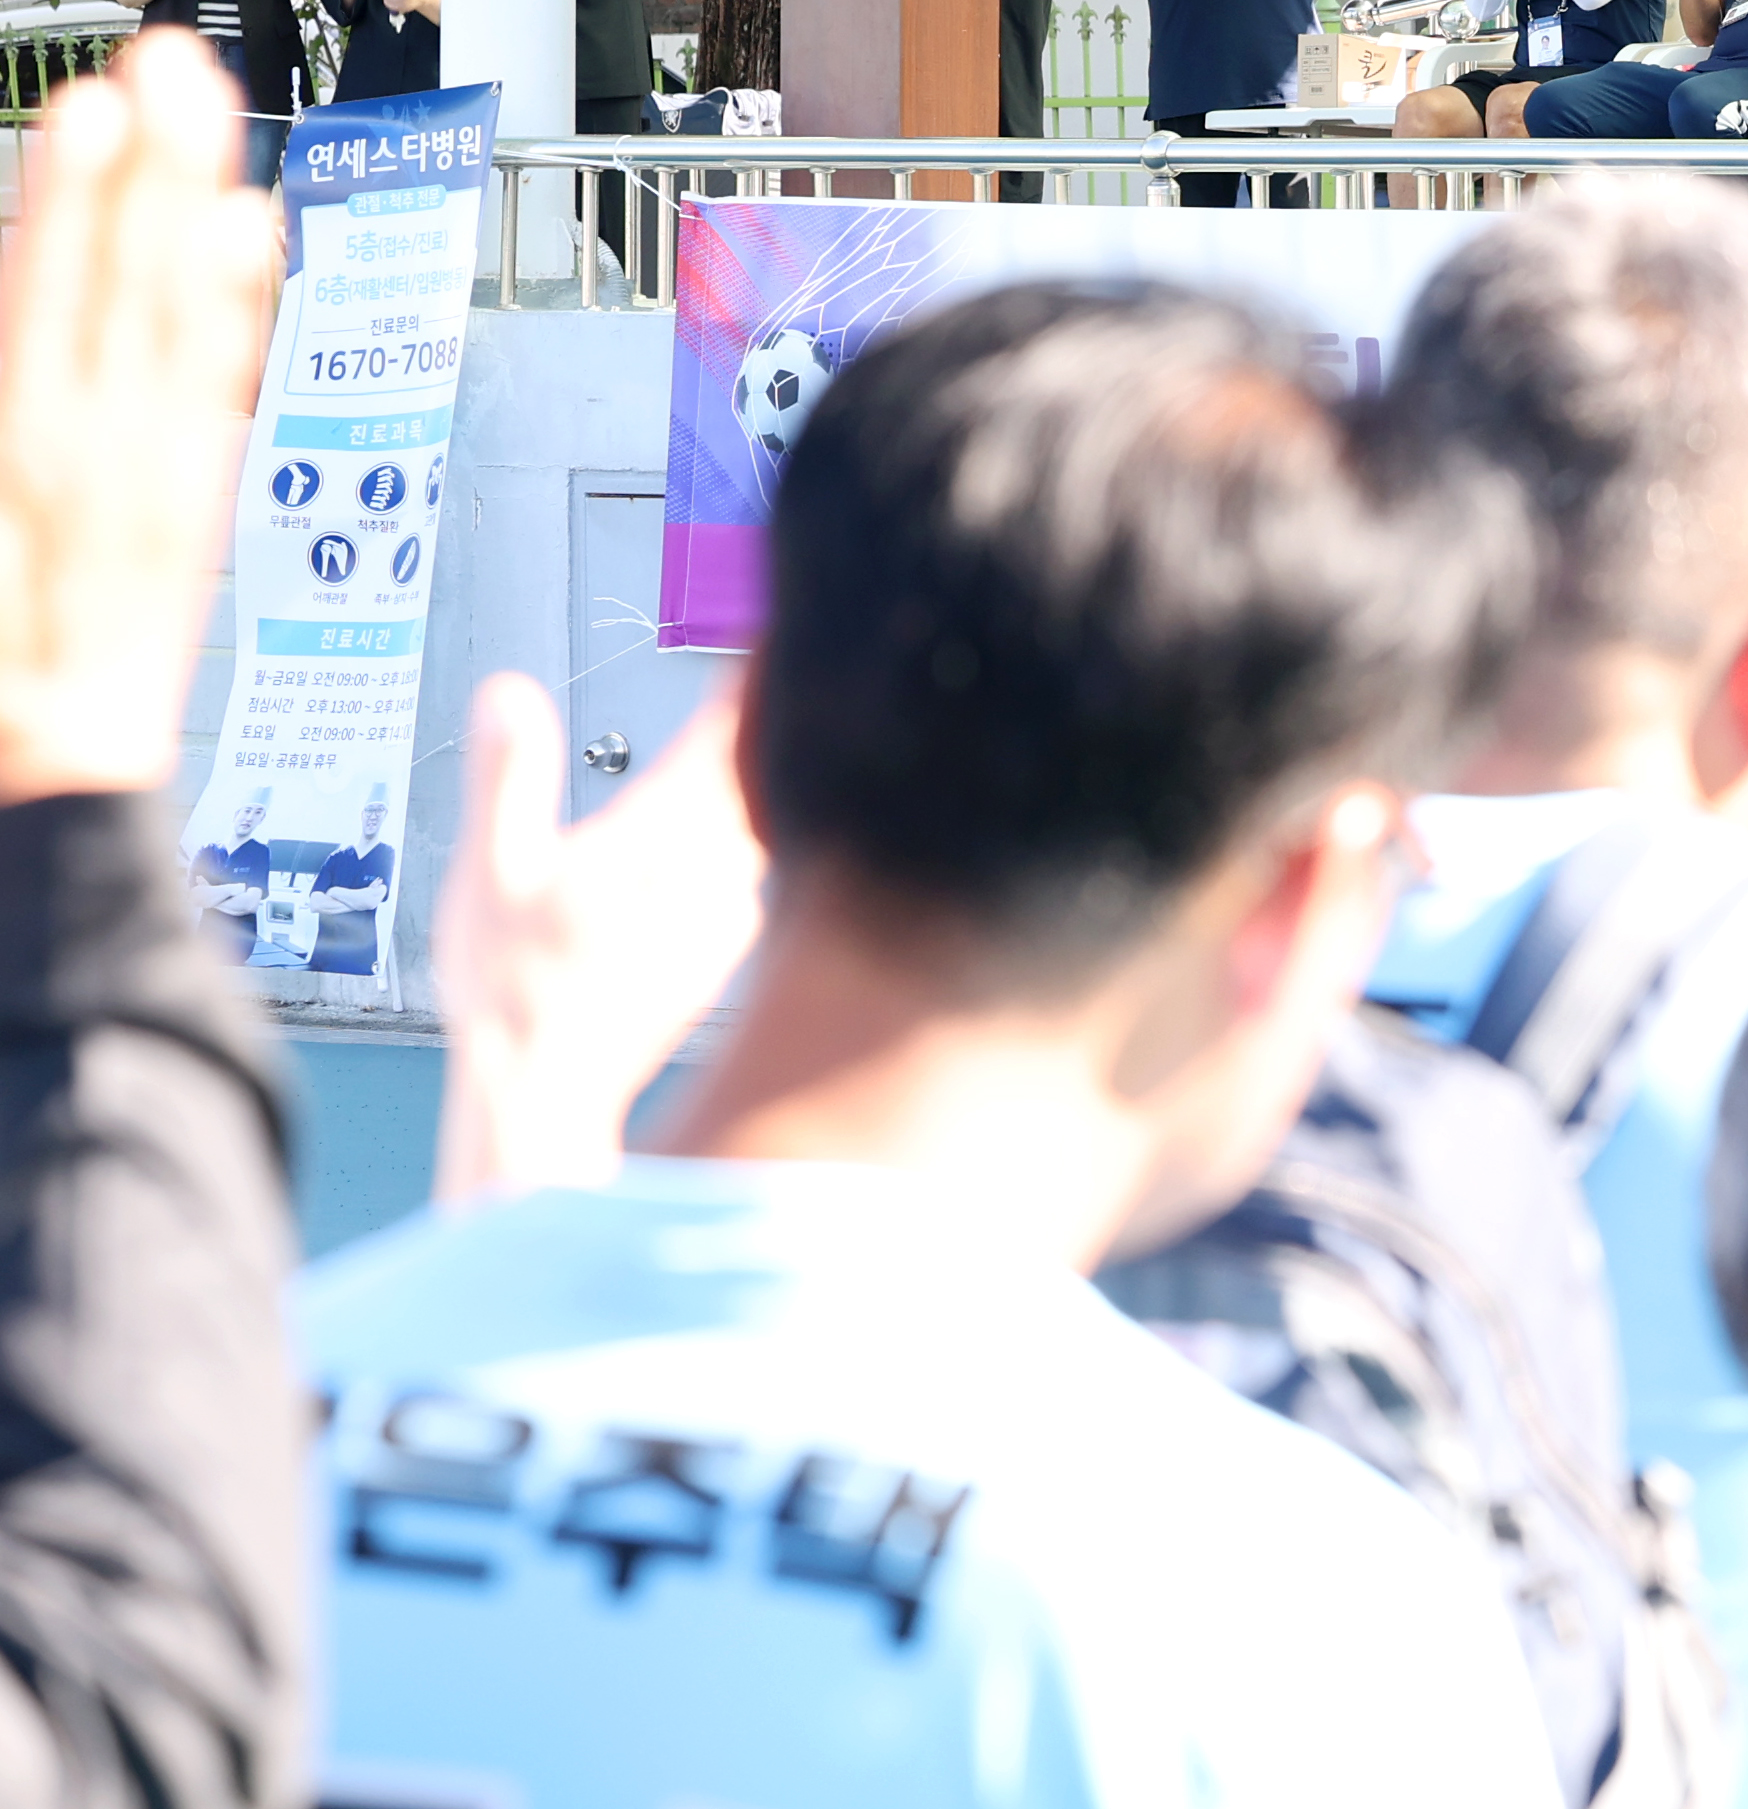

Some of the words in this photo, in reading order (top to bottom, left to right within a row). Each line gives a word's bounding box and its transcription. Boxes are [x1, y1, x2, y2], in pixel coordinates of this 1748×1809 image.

[306, 124, 482, 183] 연세스타병원
[370, 314, 419, 336] 진료문의
[309, 335, 459, 381] 1670-7088
[320, 628, 391, 651] 진료시간
[312, 671, 336, 687] 오전
[247, 696, 295, 714] 점심시간
[304, 699, 330, 714] 오후
[240, 724, 276, 740] 토요일
[298, 726, 323, 742] 오전
[365, 727, 388, 742] 오후
[313, 754, 338, 769] 휴무
[312, 1381, 976, 1651] 은주택
